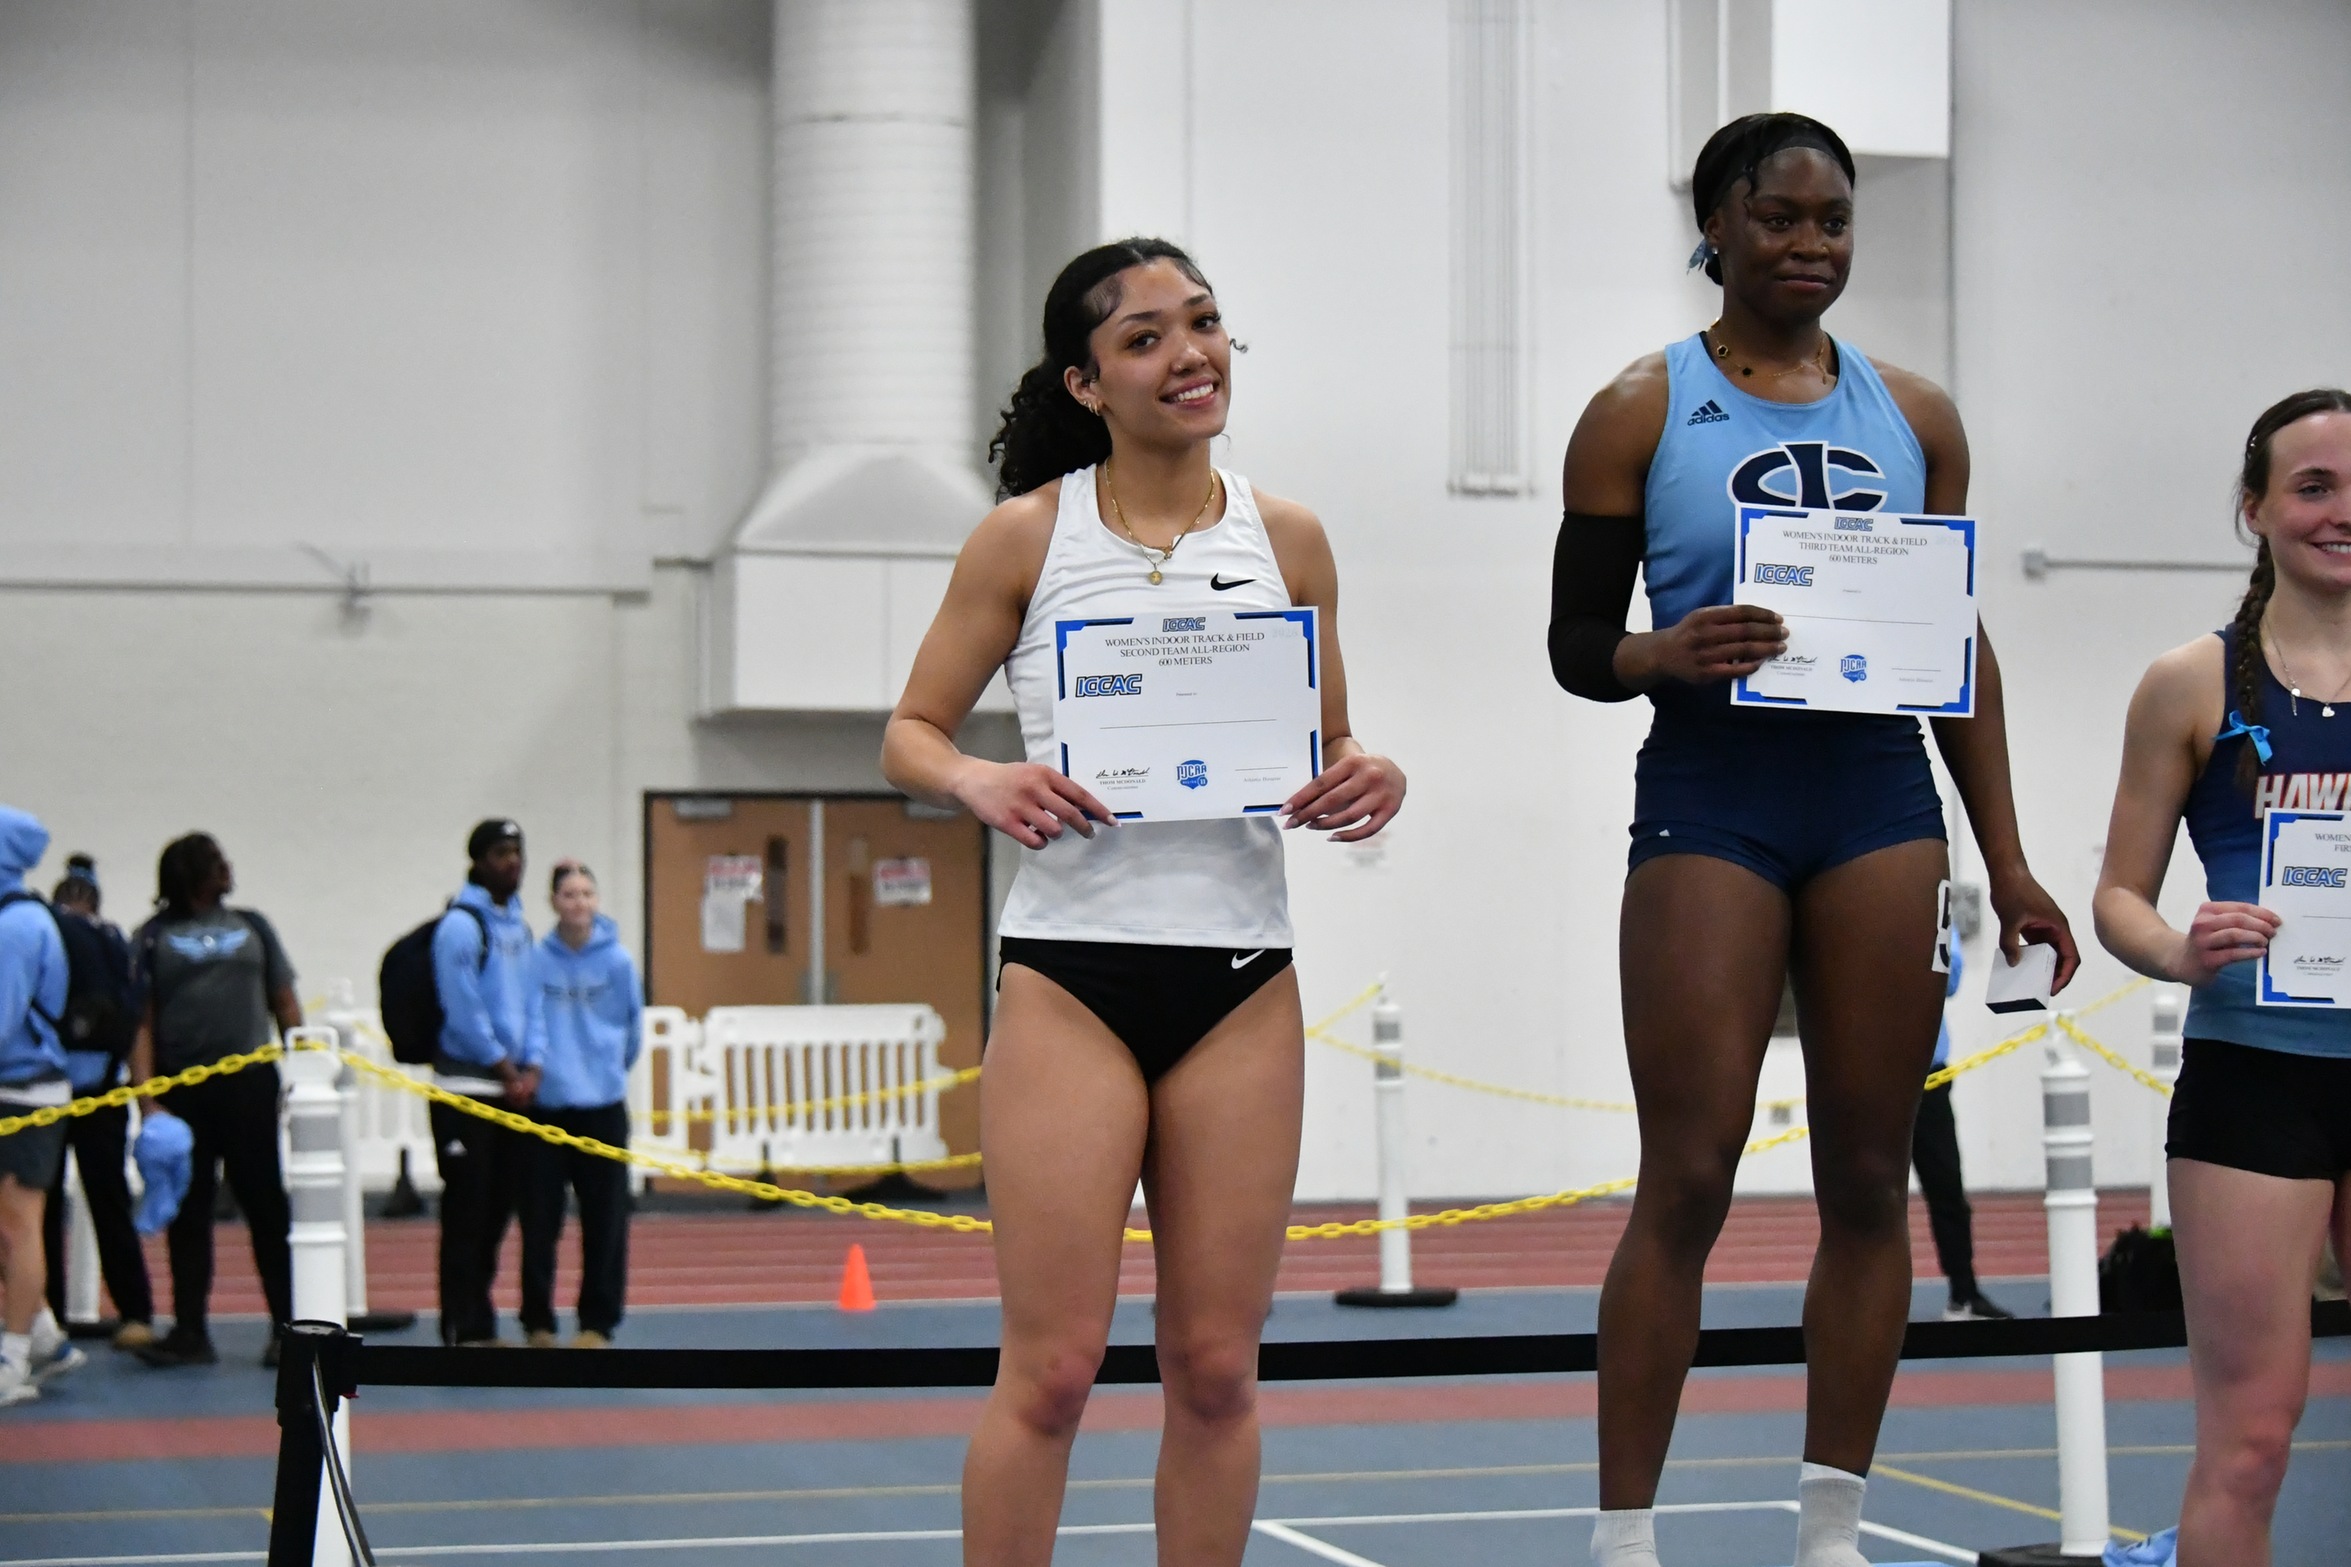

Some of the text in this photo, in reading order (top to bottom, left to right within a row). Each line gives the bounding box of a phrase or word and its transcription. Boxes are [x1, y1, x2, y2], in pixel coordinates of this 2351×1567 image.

[1687, 413, 1730, 426] adidas
[1834, 517, 1874, 531] ICCAC
[1782, 530, 1823, 541] WOMEN'S
[1824, 532, 1858, 543] INDOOR
[1861, 535, 1890, 544] TRACK
[1900, 538, 1928, 546] FIELD
[1800, 542, 1909, 556] THIRD TEAM ALL-REGION
[1829, 554, 1878, 564] 600 METERS
[1754, 563, 1814, 586] ICCAC
[1162, 617, 1206, 632] ICCAC
[1105, 637, 1150, 647] WOMEN'S
[1152, 635, 1190, 645] INDOOR
[1192, 634, 1224, 643] TRACK
[1236, 632, 1265, 641] FIELD
[1120, 644, 1250, 657] SECOND TEAM ALL-REGION
[1158, 656, 1213, 666] 600 METERS
[1840, 659, 1867, 672] NJCAA
[1075, 673, 1143, 698] ICCAC
[1176, 765, 1207, 780] NJCAA
[2253, 773, 2351, 819] HAW
[2334, 844, 2351, 853] FIR
[2282, 866, 2348, 888] ICCAC
